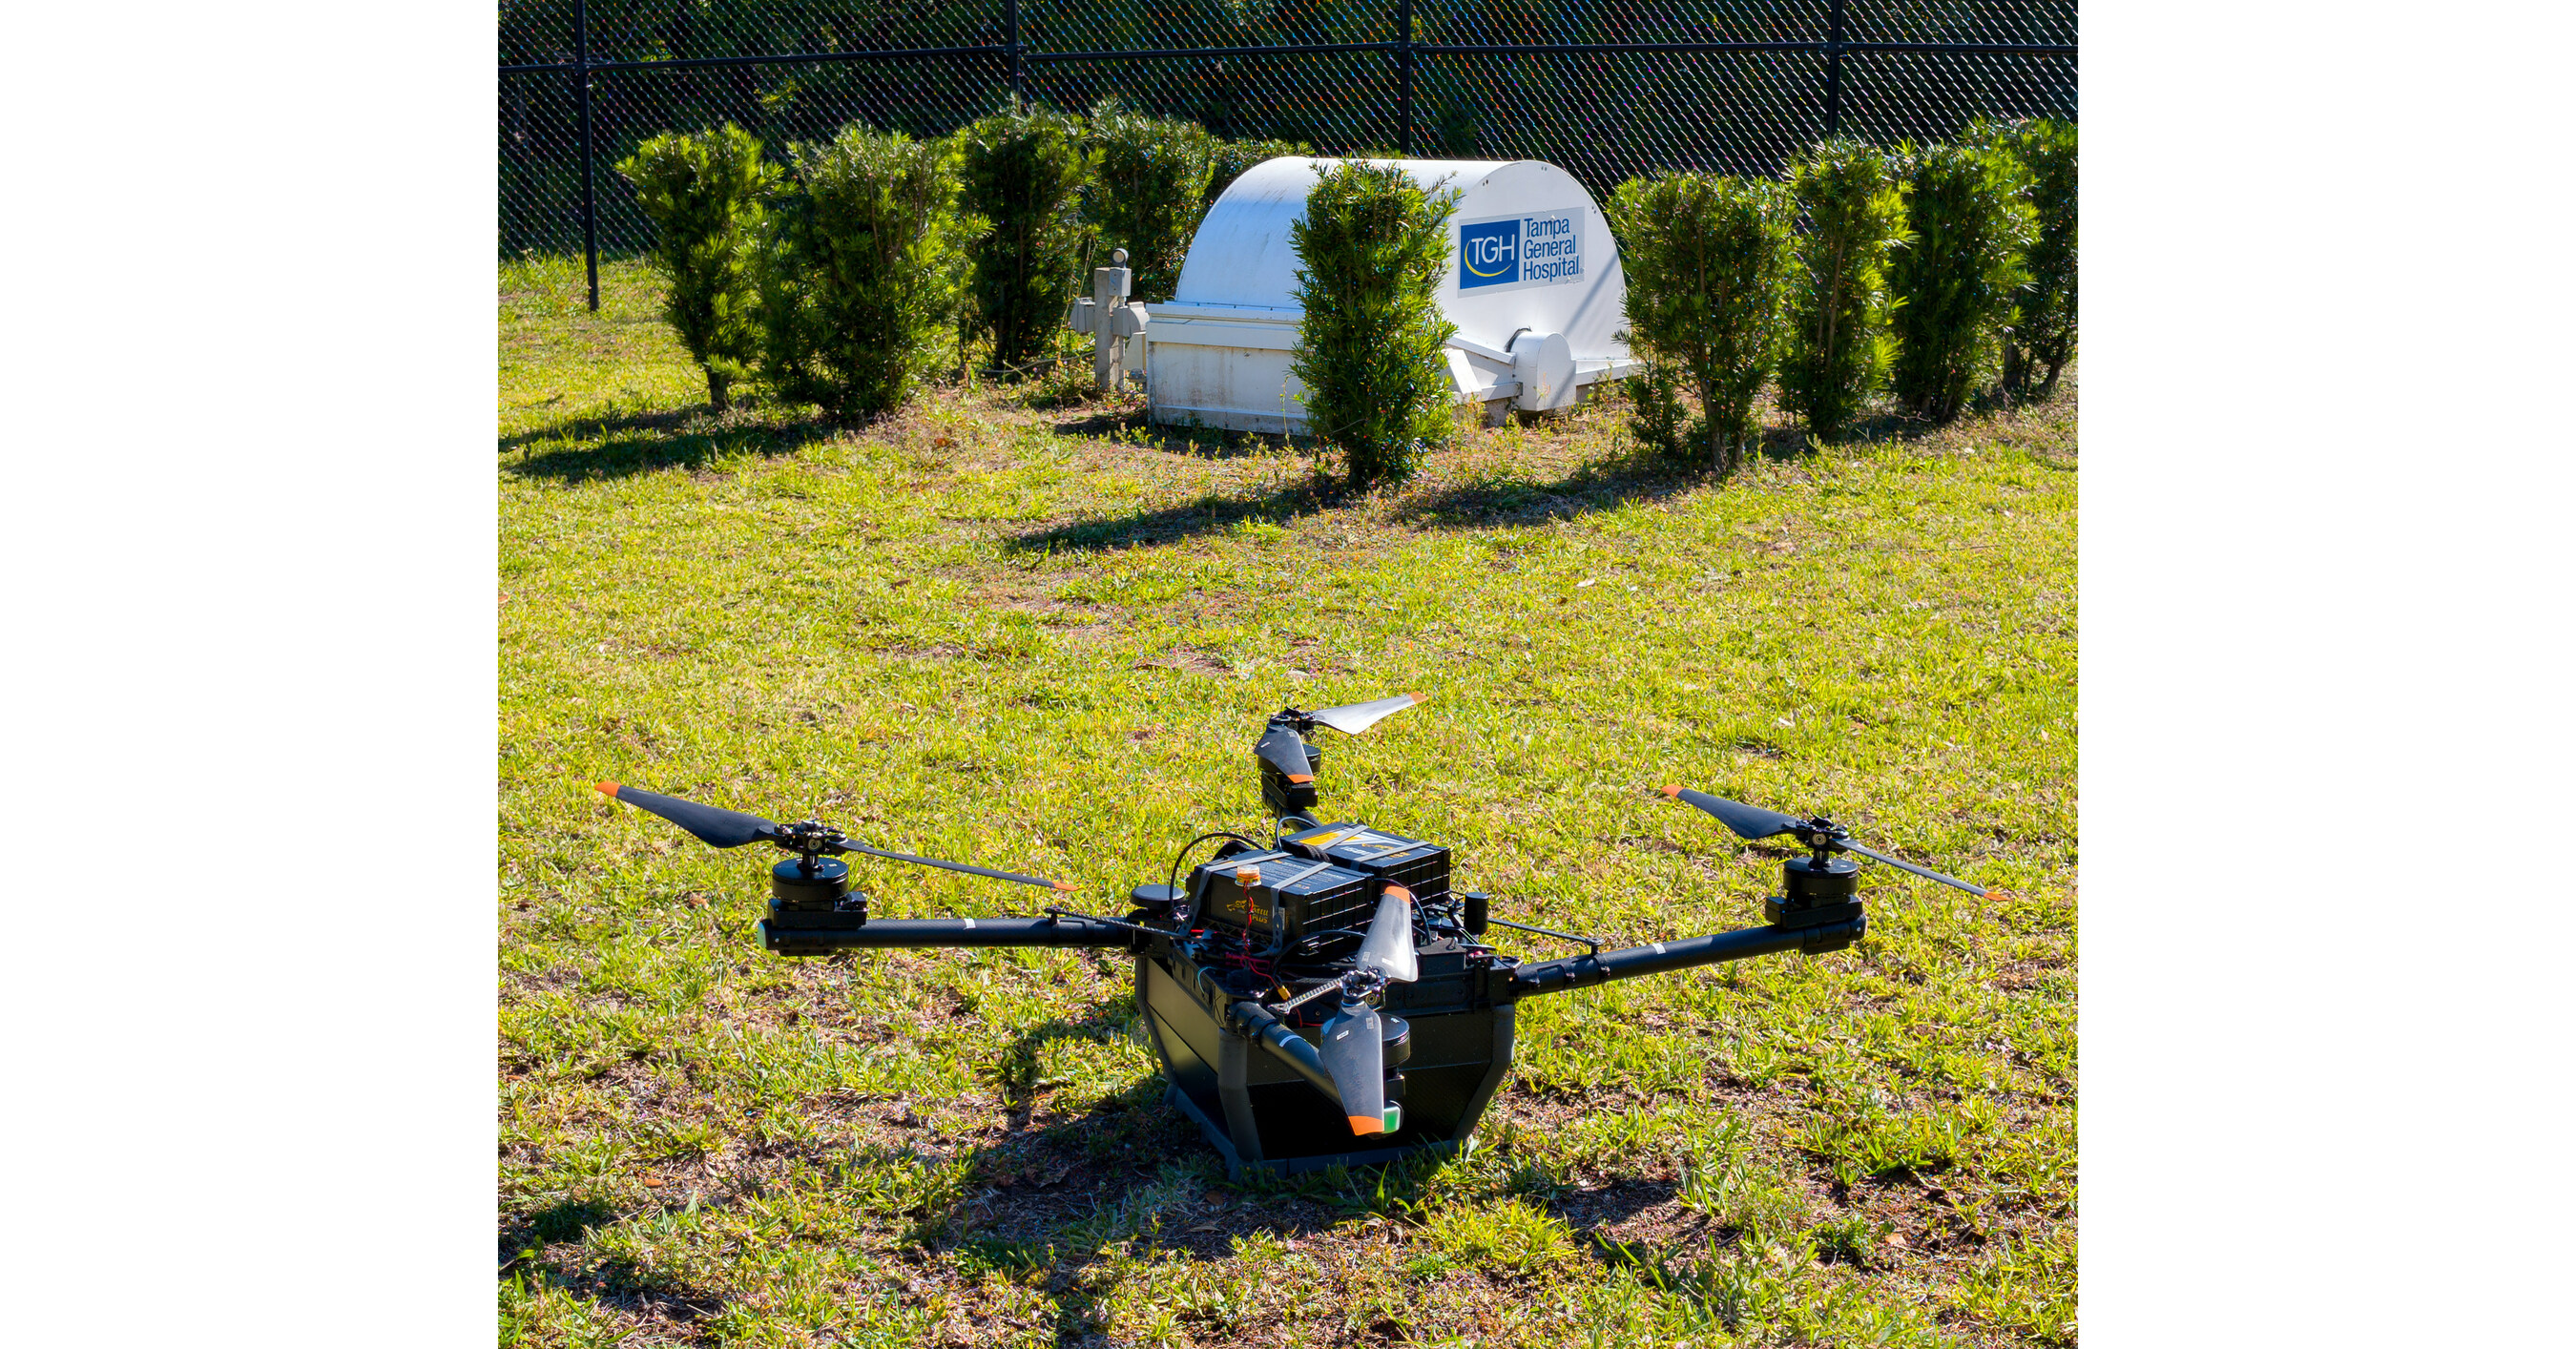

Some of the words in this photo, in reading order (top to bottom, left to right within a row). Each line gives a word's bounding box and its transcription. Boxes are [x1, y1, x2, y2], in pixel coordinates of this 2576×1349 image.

[1524, 218, 1570, 239] Tampa
[1470, 234, 1515, 265] TGH
[1524, 234, 1576, 259] General
[1523, 255, 1579, 282] Hospital
